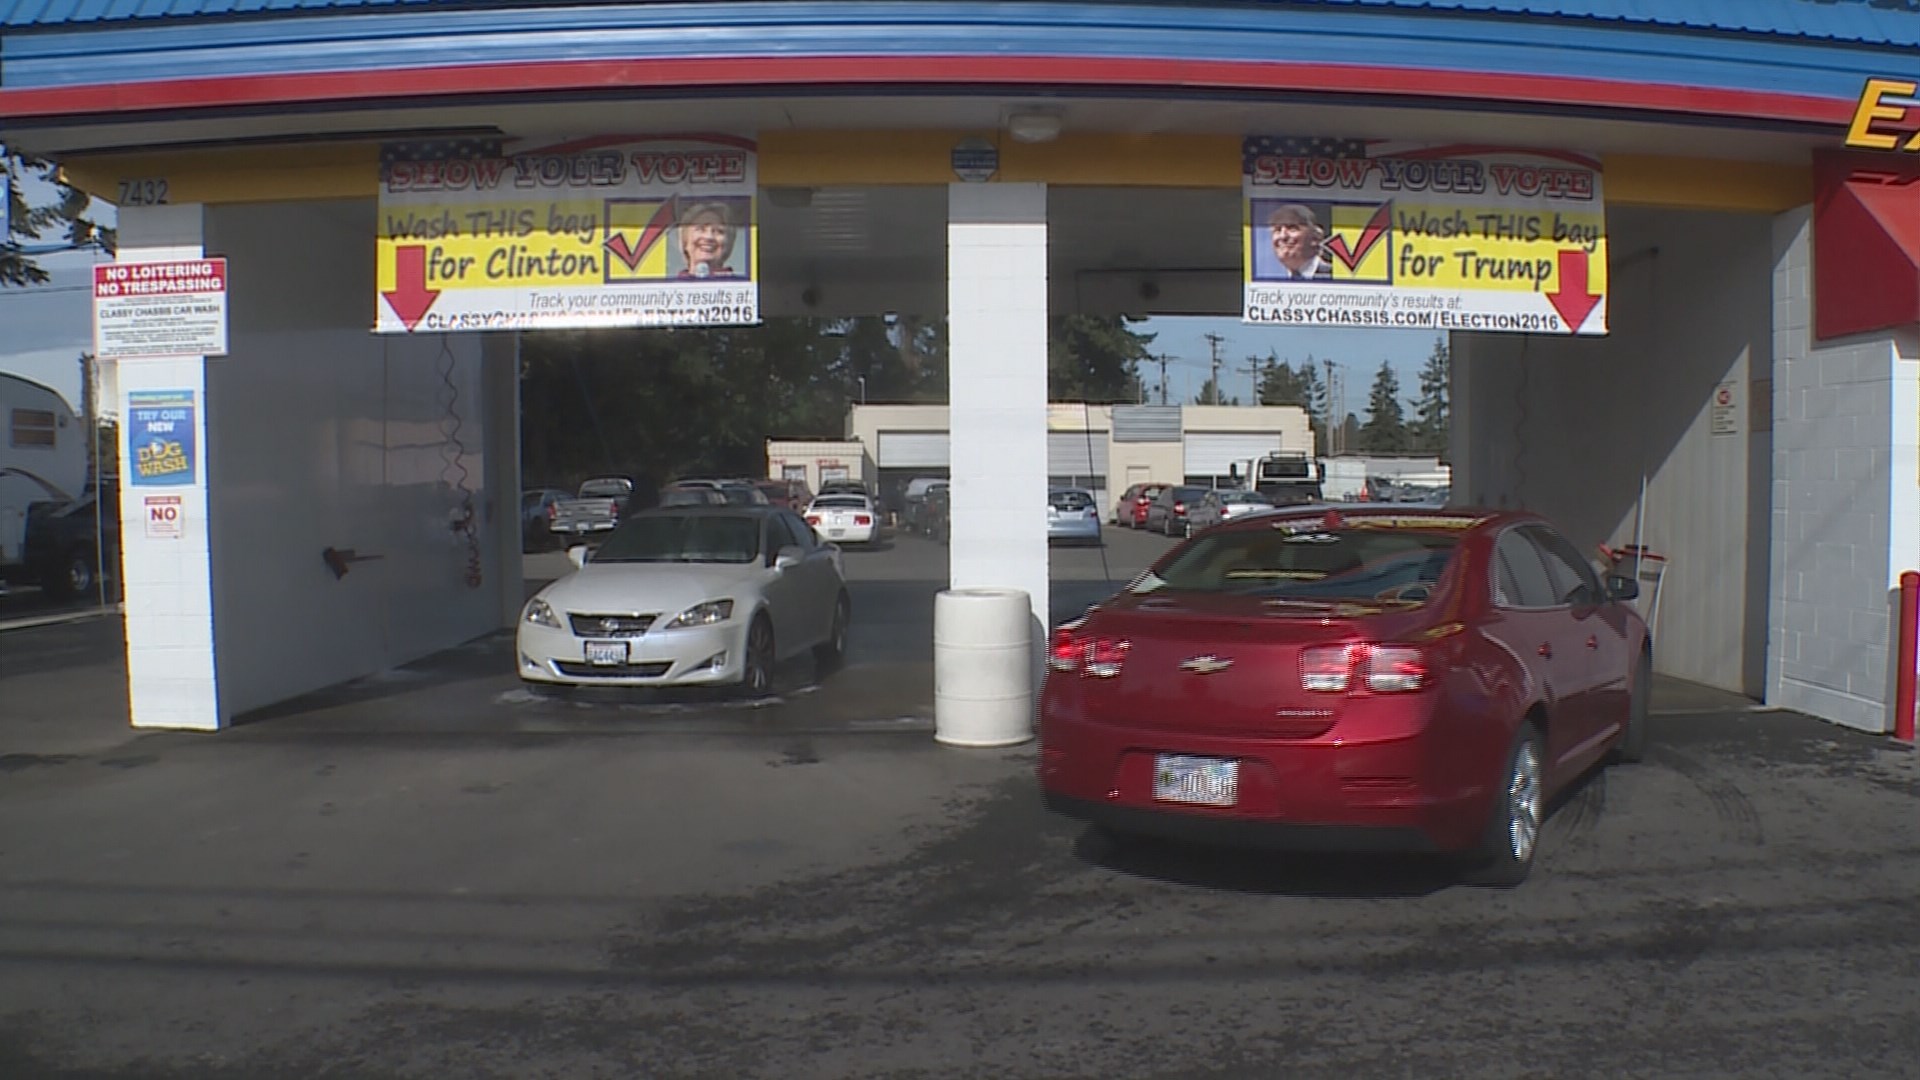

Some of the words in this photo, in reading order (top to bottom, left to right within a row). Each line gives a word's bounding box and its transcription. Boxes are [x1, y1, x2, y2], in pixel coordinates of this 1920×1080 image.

[388, 158, 505, 193] SHOW
[514, 152, 627, 188] YOUR
[631, 152, 746, 184] VOTE
[1252, 156, 1371, 188] SHOW
[1380, 159, 1486, 191] YOUR
[1490, 164, 1593, 199] VOTE
[118, 178, 168, 206] 7432
[387, 210, 459, 241] Wash
[465, 209, 535, 238] THIS
[547, 204, 596, 244] bay
[1398, 210, 1470, 238] Wash
[1476, 213, 1540, 241] THIS
[1553, 212, 1598, 253] bay
[106, 267, 128, 280] NO
[131, 263, 212, 279] LOITERING
[428, 246, 475, 281] for
[486, 245, 599, 279] Clinton
[1399, 244, 1444, 277] for
[1453, 250, 1552, 292] Trump
[98, 282, 119, 295] NO
[121, 277, 221, 294] TRESPASSING
[530, 293, 566, 308] Track
[568, 295, 598, 312] your
[600, 290, 684, 308] community's
[687, 289, 733, 305] results
[1250, 289, 1284, 305] Track
[1288, 293, 1317, 309] your
[1319, 291, 1399, 309] community's
[1402, 294, 1443, 309] results
[100, 309, 133, 318] CLASSY
[134, 306, 172, 317] CHASSIS
[173, 305, 192, 315] CAR
[194, 304, 220, 313] WASH
[161, 409, 187, 421] OUR
[147, 422, 174, 432] NEW
[137, 455, 189, 478] WASH
[151, 506, 177, 521] NO
